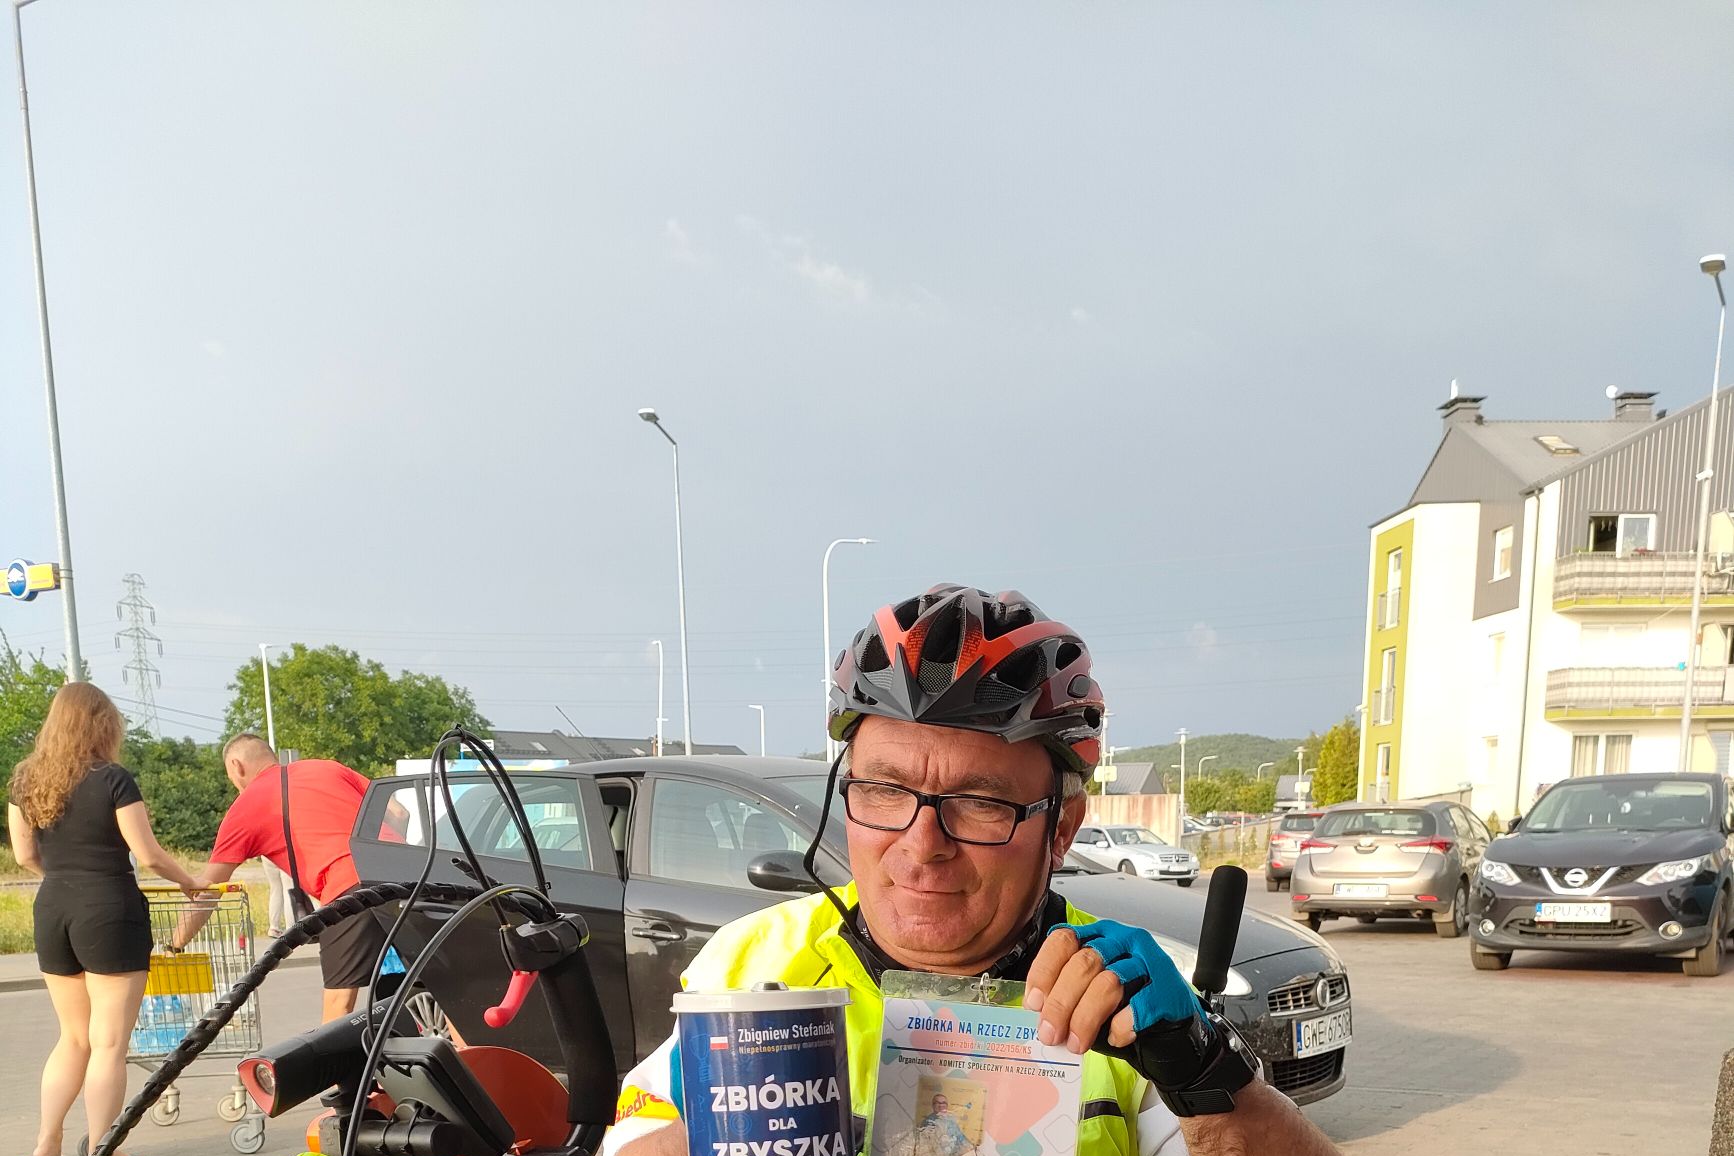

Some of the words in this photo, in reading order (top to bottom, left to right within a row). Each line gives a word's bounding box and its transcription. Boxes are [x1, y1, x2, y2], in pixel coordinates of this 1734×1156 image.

[737, 1026, 790, 1045] Zbigniew
[791, 1021, 835, 1039] Stefaniak
[907, 1016, 953, 1032] ZBIÓRKA
[958, 1021, 972, 1035] NA
[977, 1023, 1011, 1038] RZECZ
[1015, 1026, 1040, 1041] ZBY
[1303, 1020, 1325, 1049] GWE
[938, 1058, 966, 1069] KOMITET
[967, 1061, 1003, 1073] SPOŁECZNY
[1004, 1065, 1014, 1073] NA
[1015, 1066, 1036, 1076] RZECZ
[1037, 1068, 1066, 1079] ZBYSZKA
[709, 1074, 841, 1113] ZBIÓRKA
[768, 1117, 798, 1131] DLA
